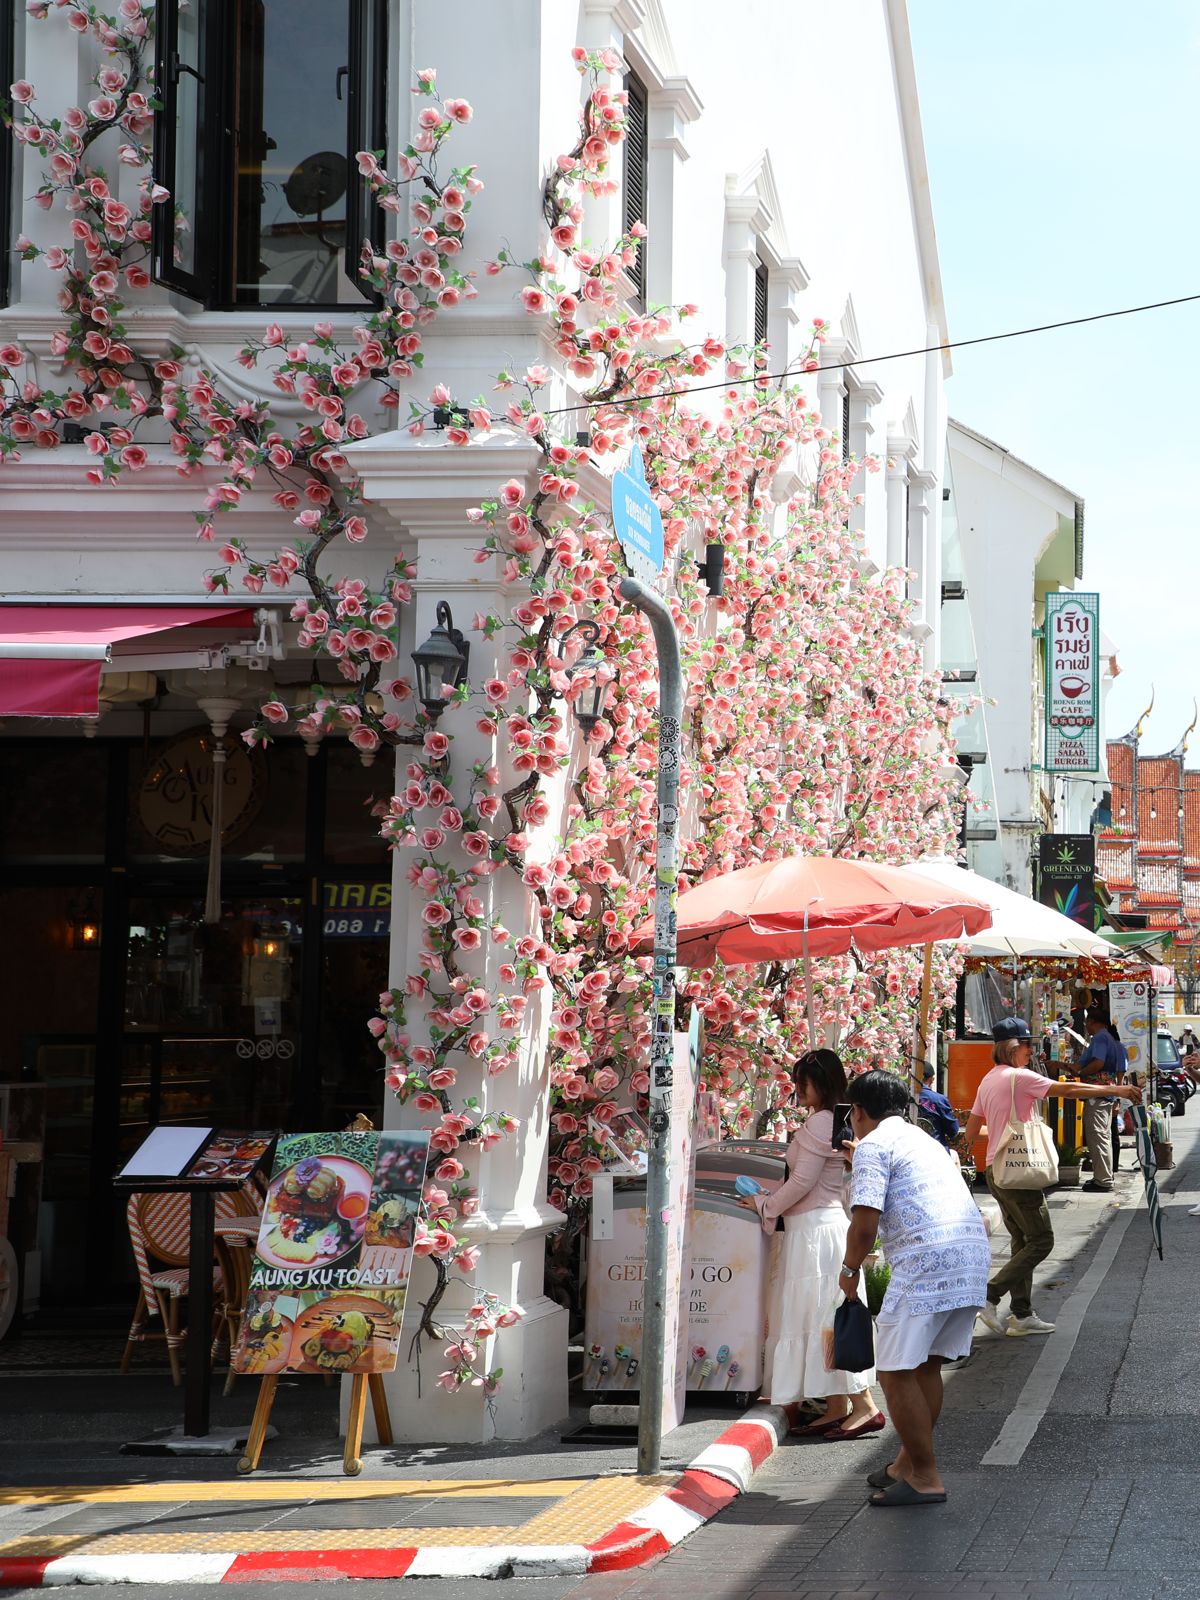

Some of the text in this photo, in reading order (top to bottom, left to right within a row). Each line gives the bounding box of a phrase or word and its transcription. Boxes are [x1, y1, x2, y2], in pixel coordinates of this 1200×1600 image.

[1055, 634, 1090, 654] รมย์
[1055, 655, 1090, 670] คาเฟ่
[251, 1269, 399, 1285] AUNG KU TOAST.
[702, 1266, 732, 1283] GO
